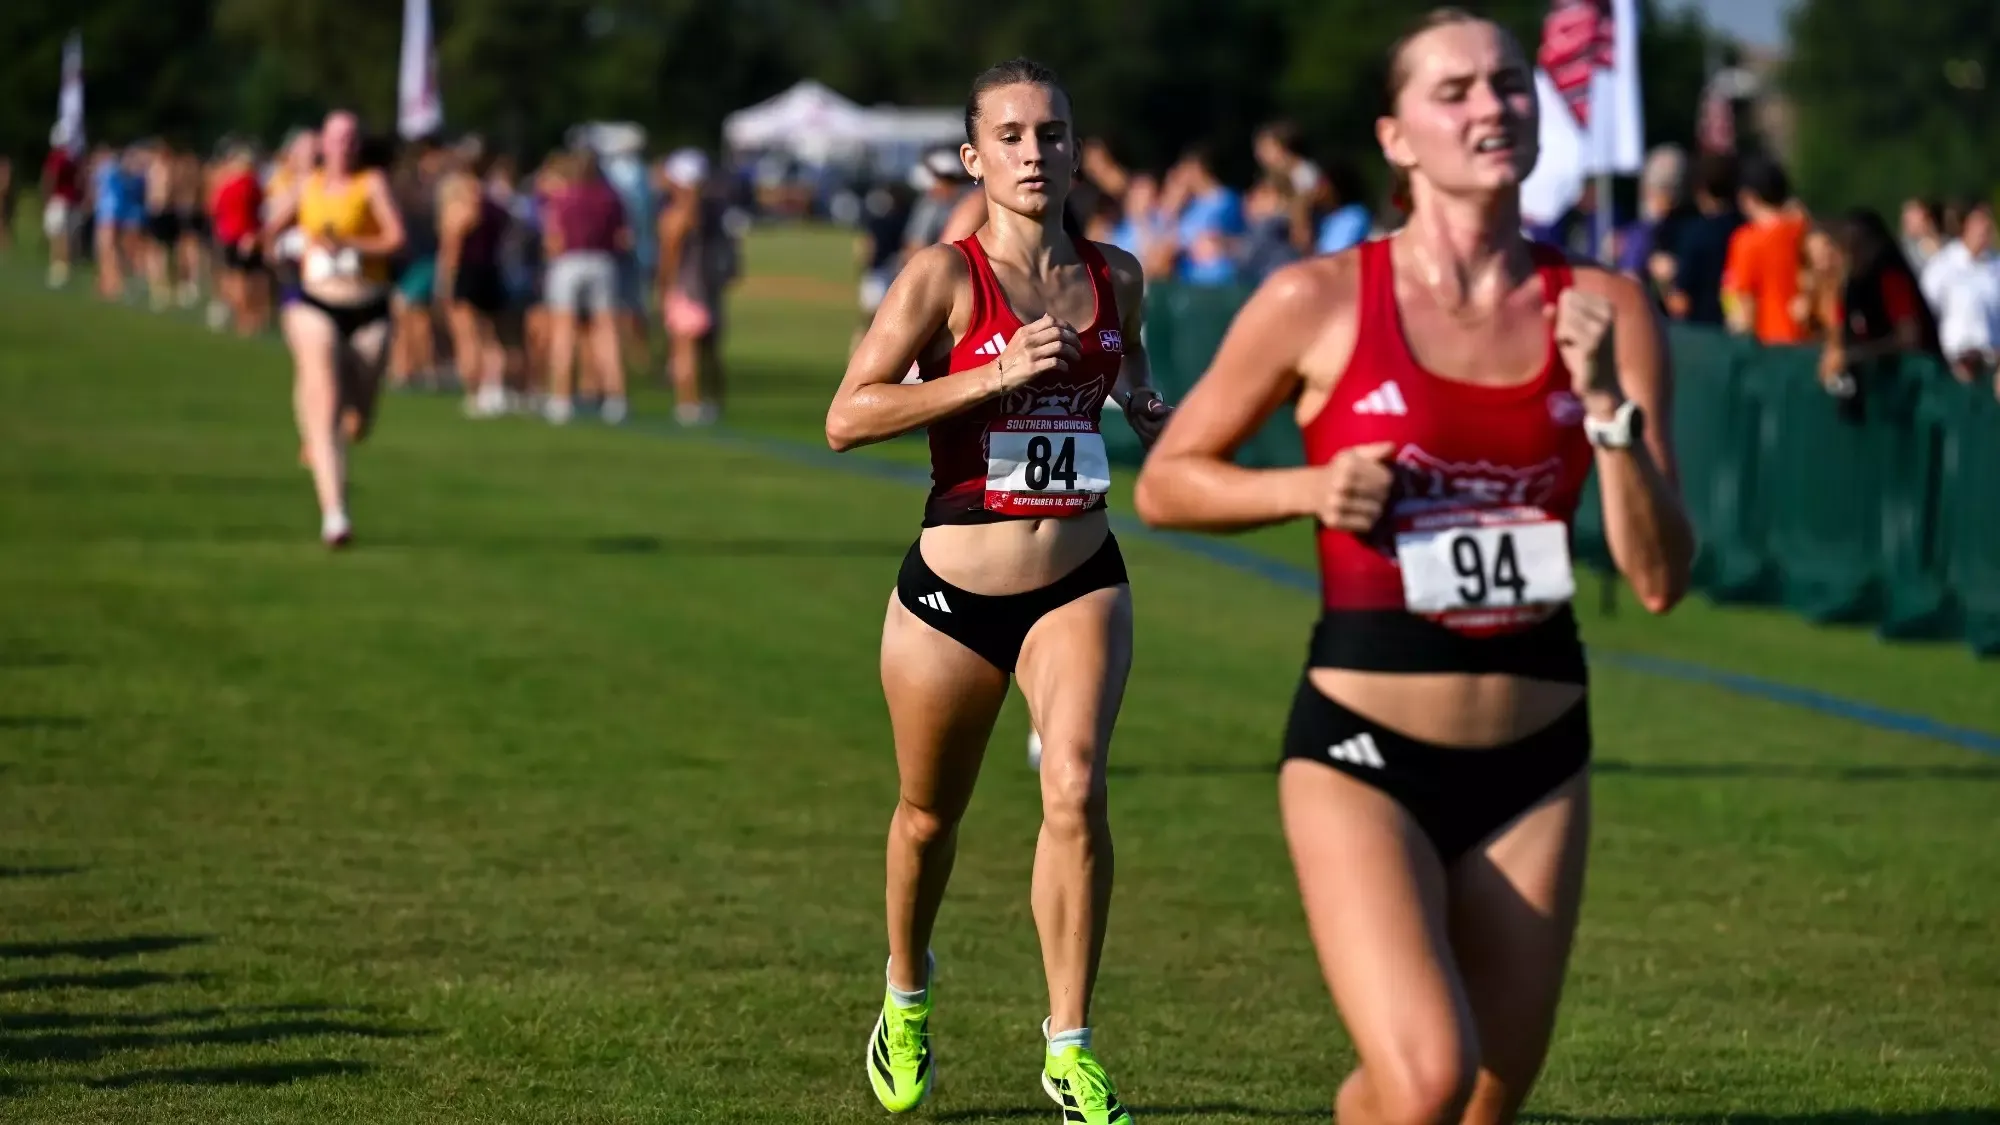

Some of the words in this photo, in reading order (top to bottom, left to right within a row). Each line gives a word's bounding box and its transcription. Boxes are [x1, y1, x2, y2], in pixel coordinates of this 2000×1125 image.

[1006, 419, 1052, 430] SOUTHERN
[1053, 420, 1093, 431] SHOWCASE
[1024, 435, 1078, 491] 84
[1012, 497, 1053, 506] SEPTEMBER
[1451, 532, 1527, 604] 94
